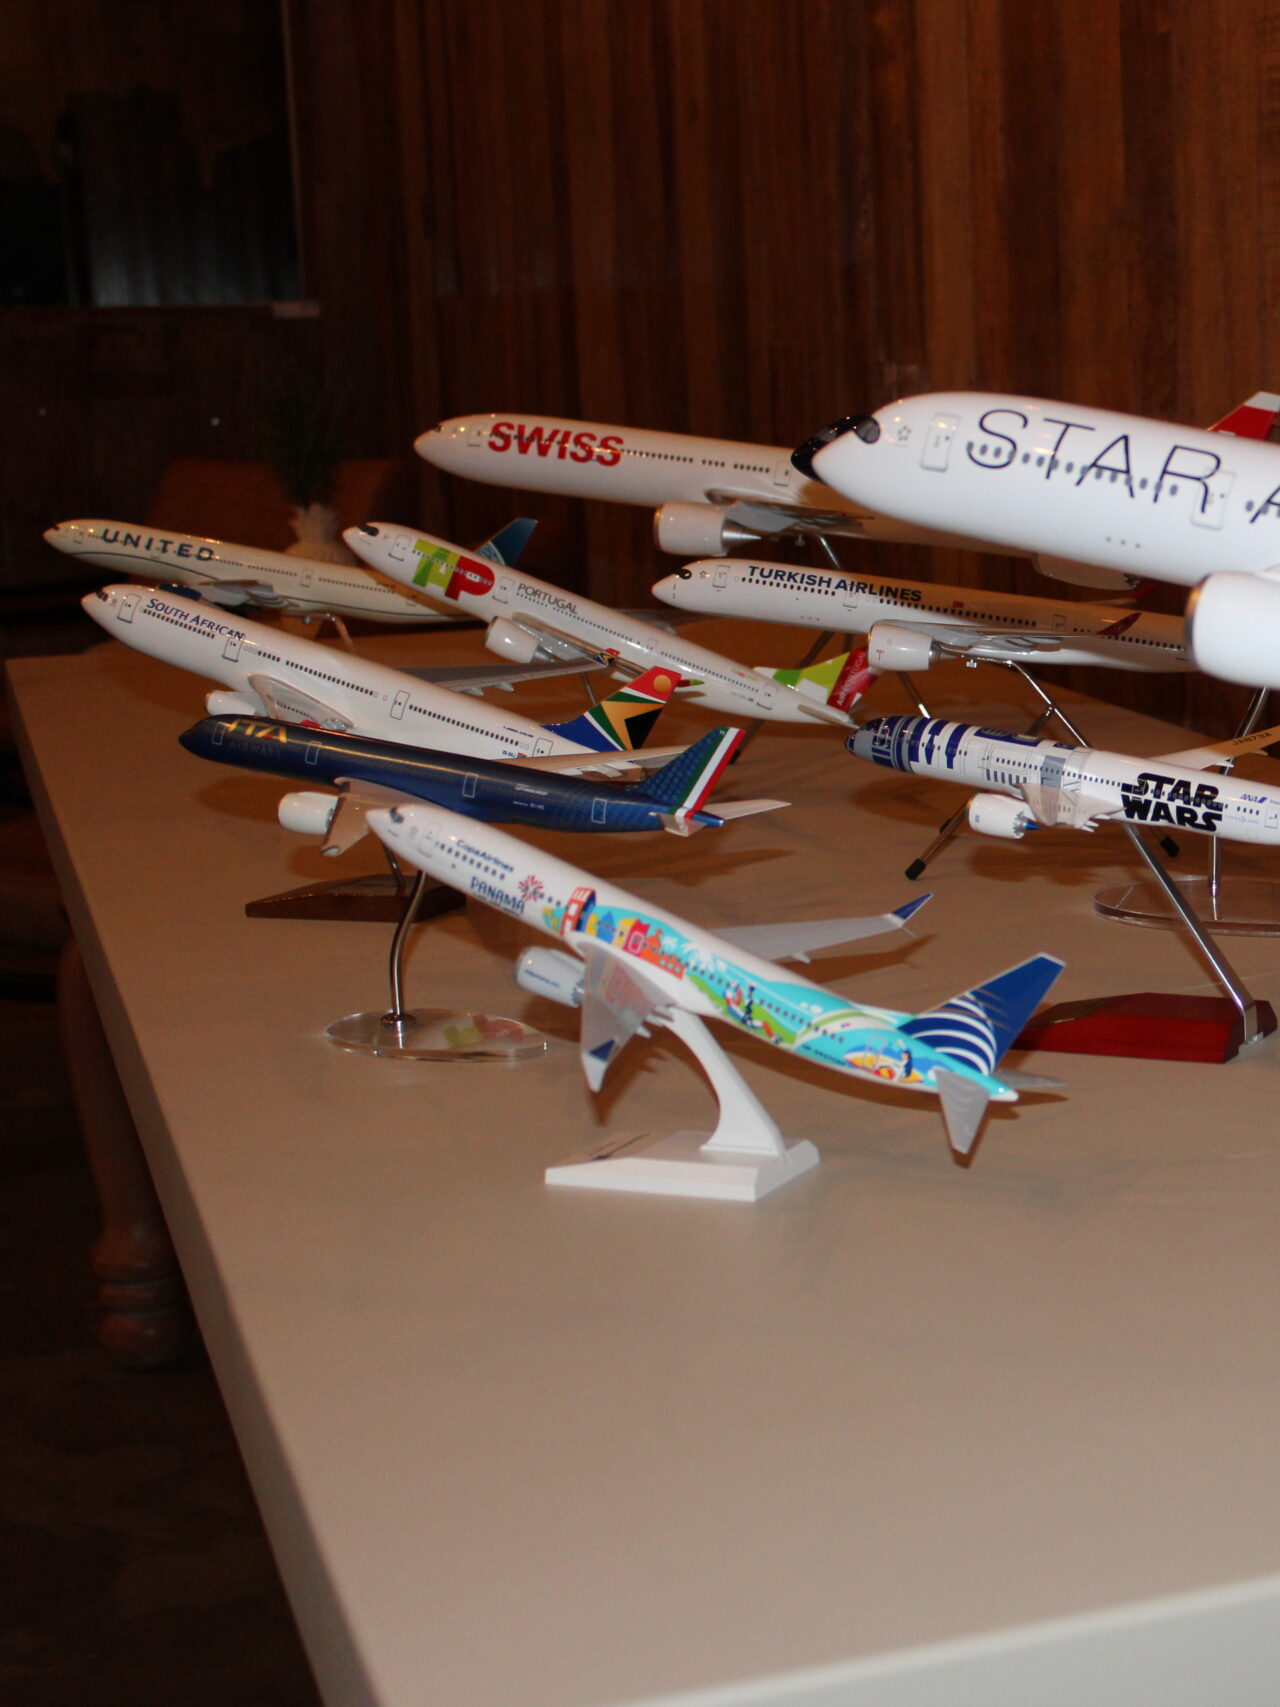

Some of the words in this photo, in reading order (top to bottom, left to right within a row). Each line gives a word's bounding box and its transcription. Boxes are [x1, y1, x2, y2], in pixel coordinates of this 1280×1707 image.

[488, 421, 624, 467] SWISS
[966, 408, 1221, 514] STAR
[101, 527, 215, 562] UNITED
[411, 538, 496, 602] TAP
[748, 565, 833, 589] TURKISH
[834, 578, 922, 602] AIRLINES
[516, 581, 579, 615] PORTUGAL
[146, 598, 191, 621] SOUTH
[191, 614, 246, 641] AFRICAN
[224, 718, 288, 744] ITA
[1121, 772, 1224, 812] STAR
[1240, 793, 1259, 803] ANA
[1121, 793, 1223, 833] WARS
[470, 875, 526, 915] PANAMA
